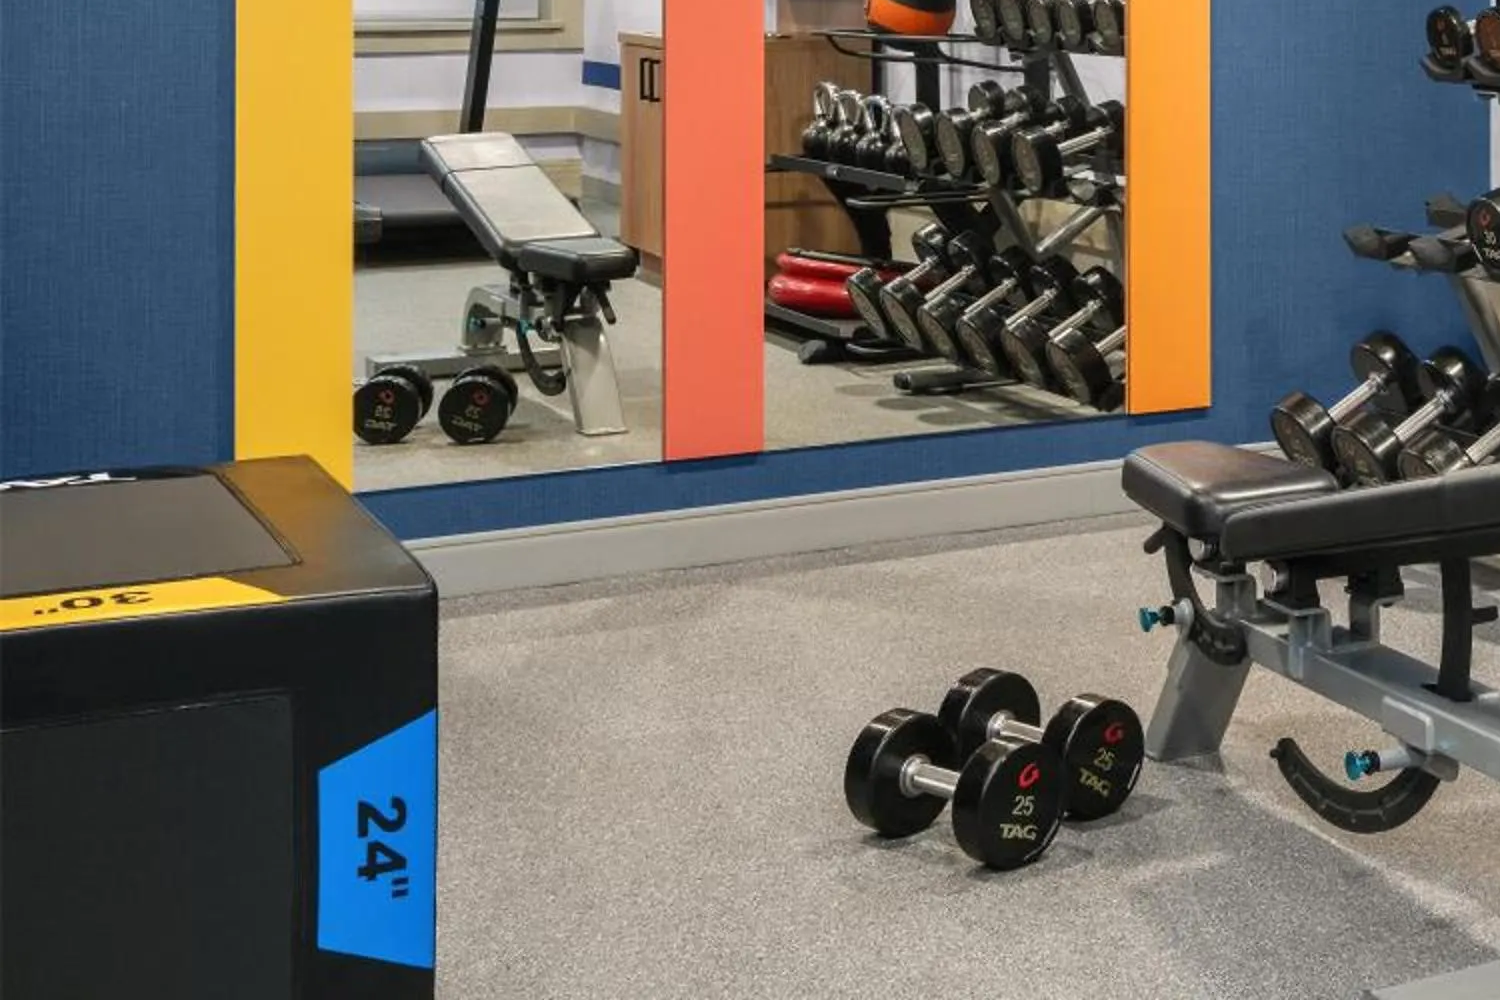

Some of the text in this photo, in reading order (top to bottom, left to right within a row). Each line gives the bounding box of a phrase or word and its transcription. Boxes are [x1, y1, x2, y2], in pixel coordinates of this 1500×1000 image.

[1093, 747, 1116, 773] 25
[1078, 766, 1111, 797] TAG
[1011, 795, 1035, 817] 25
[1000, 823, 1040, 842] TAG
[357, 796, 409, 899] 24"
